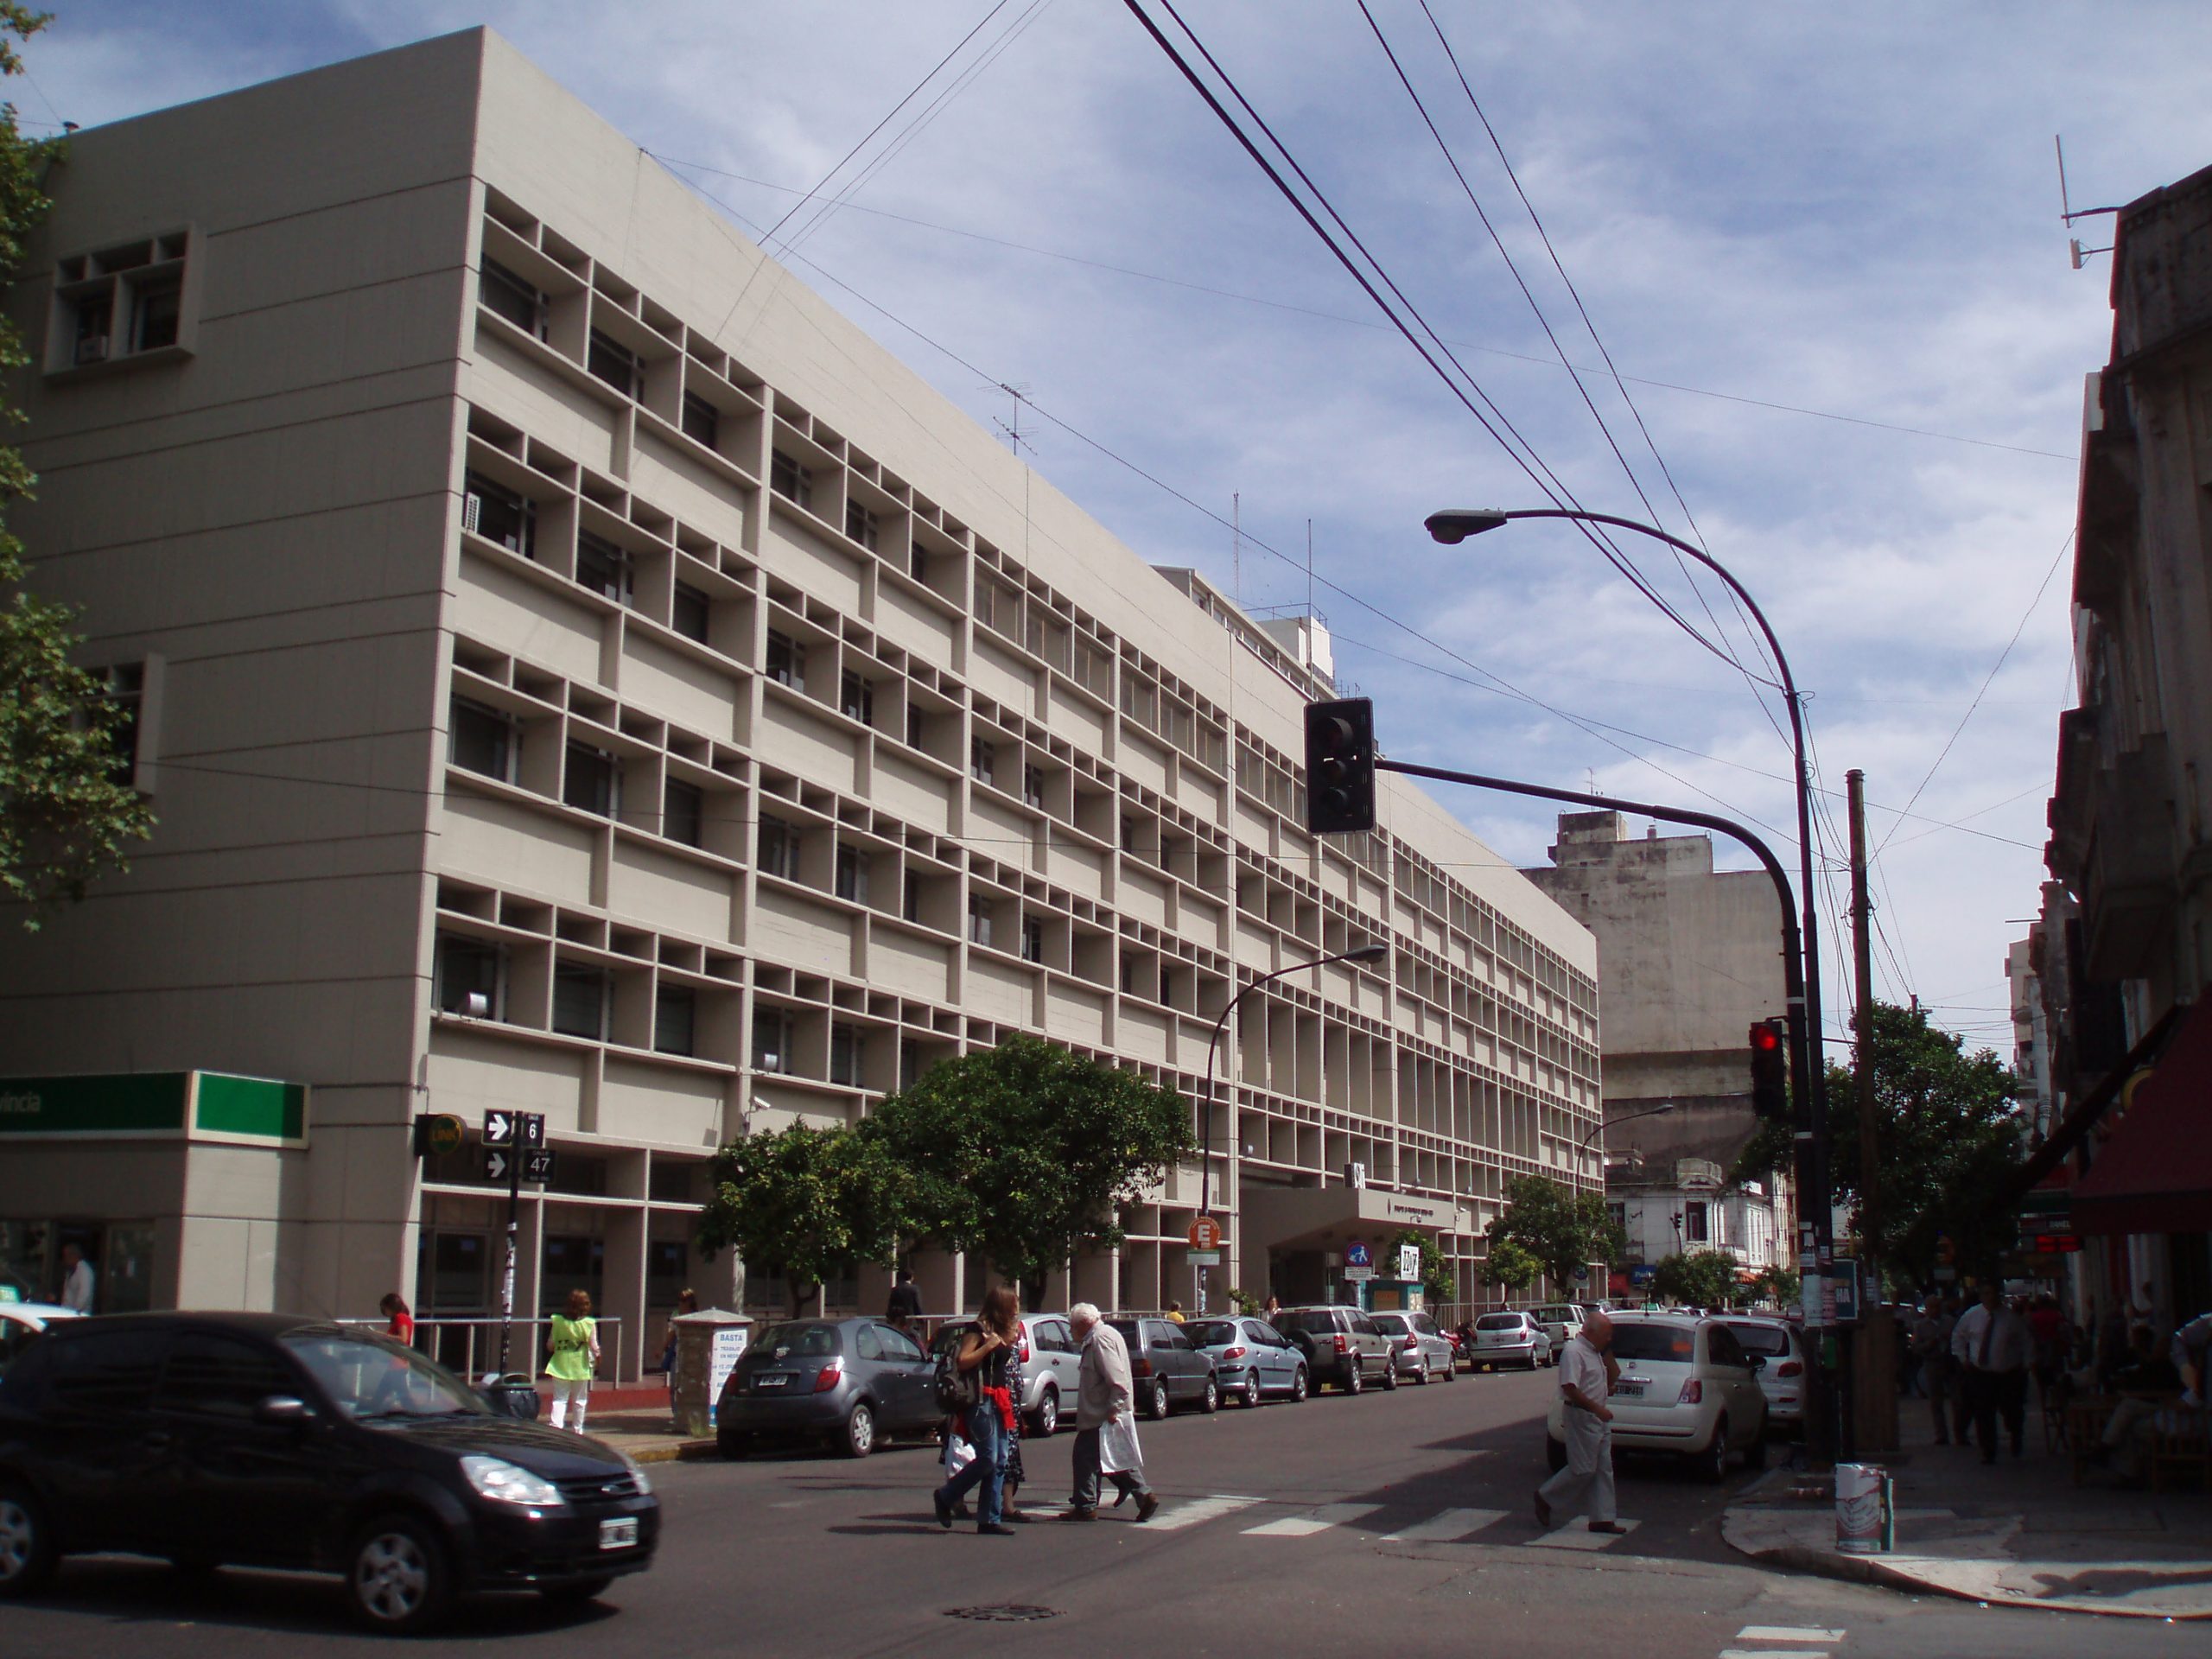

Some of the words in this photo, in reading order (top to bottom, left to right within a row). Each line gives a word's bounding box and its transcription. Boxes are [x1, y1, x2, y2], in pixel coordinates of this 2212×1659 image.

[529, 1123, 537, 1139] 6
[531, 1157, 550, 1172] 47
[1198, 1224, 1211, 1242] E
